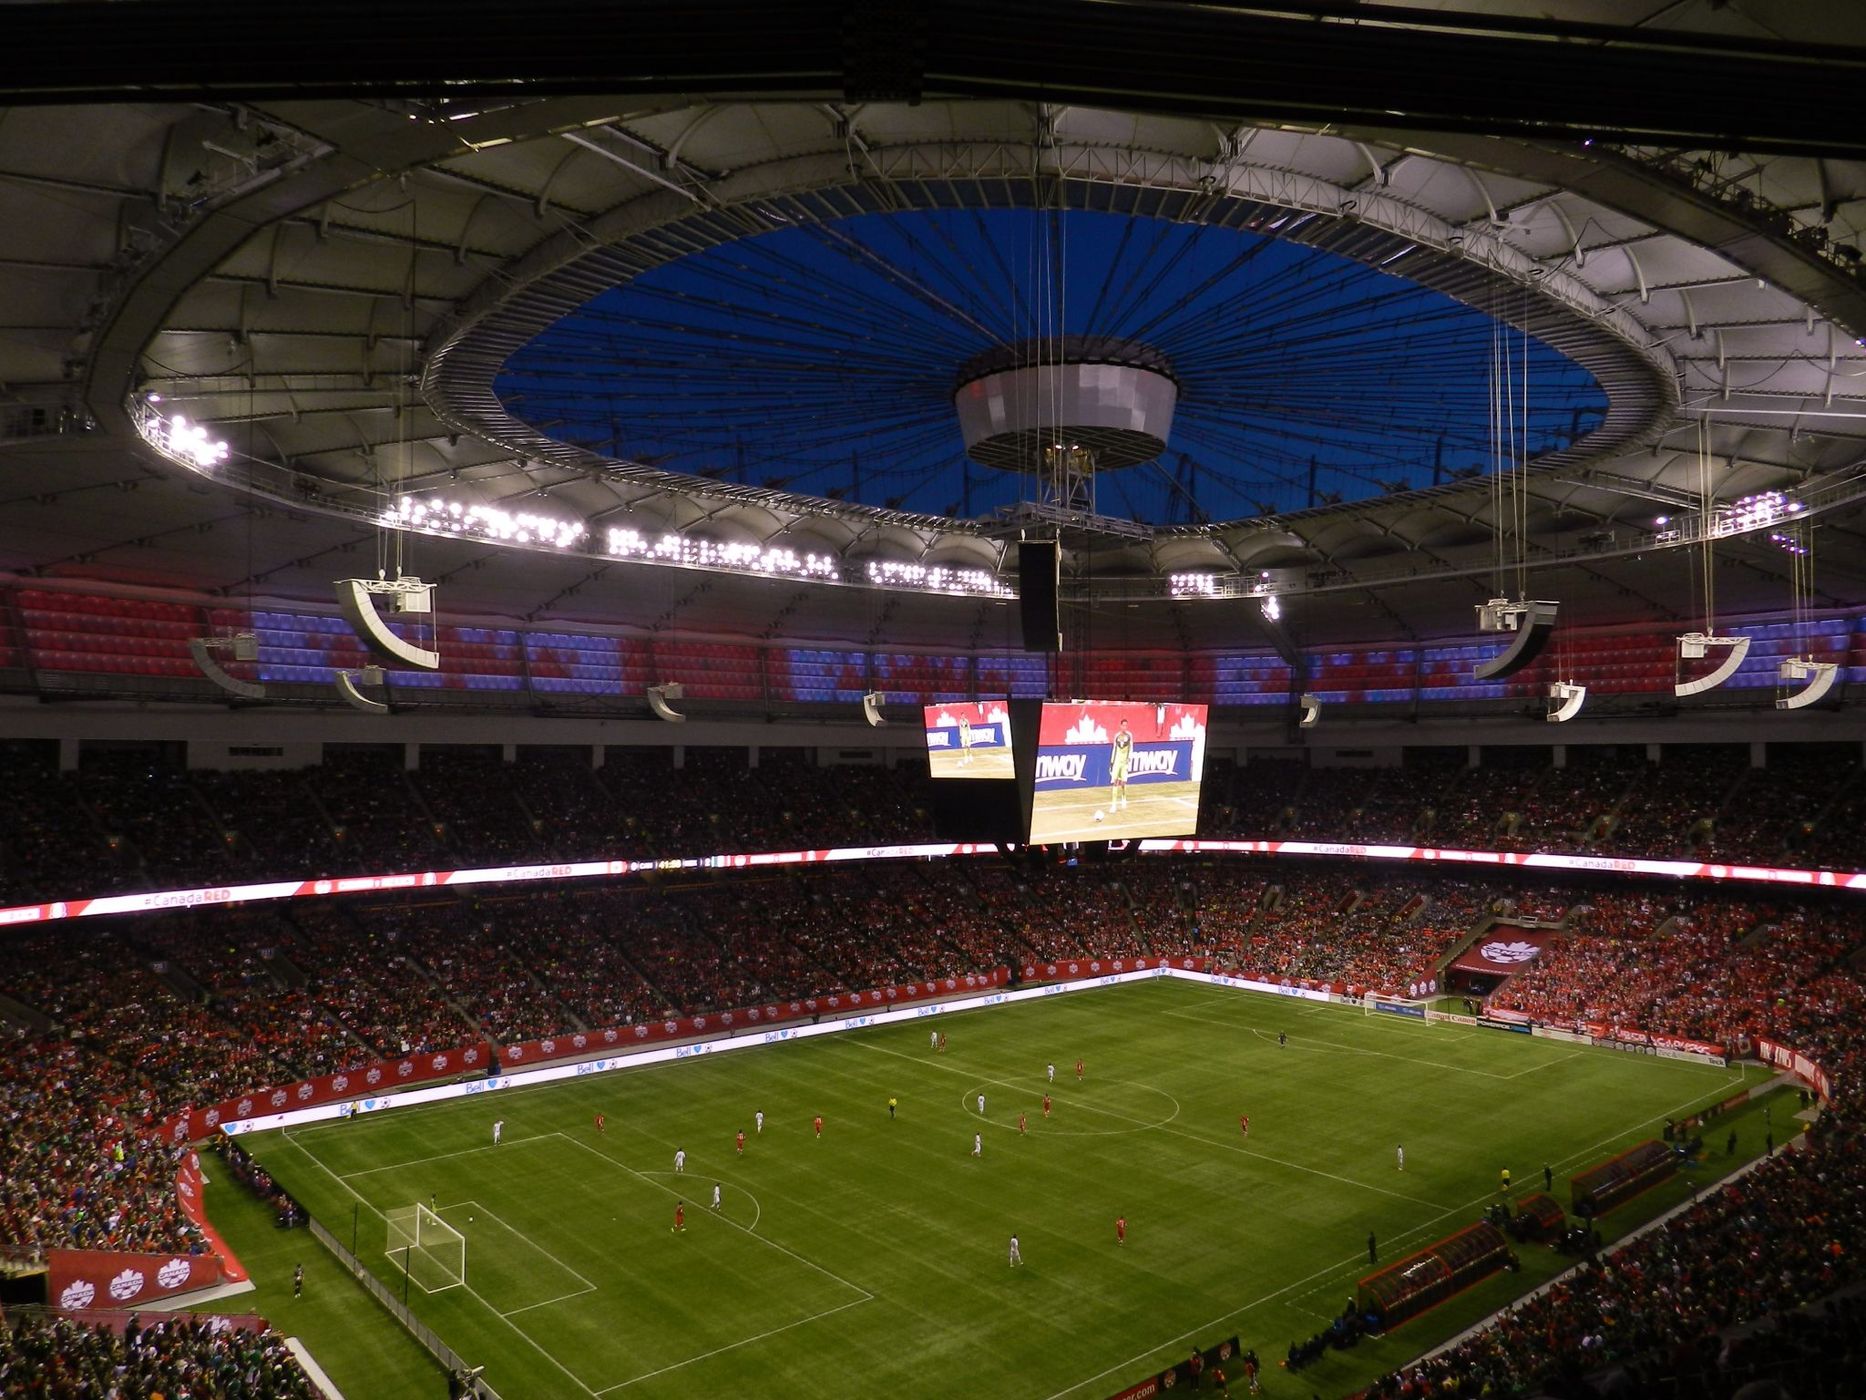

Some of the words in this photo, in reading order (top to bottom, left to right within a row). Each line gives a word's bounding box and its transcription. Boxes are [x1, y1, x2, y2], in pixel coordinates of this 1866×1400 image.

[969, 728, 994, 743] mway
[1035, 755, 1086, 781] mway
[1128, 751, 1178, 774] mway
[145, 889, 231, 906] #CanadaRED
[676, 1047, 691, 1058] Bell
[577, 1063, 594, 1075] Bell
[466, 1081, 484, 1094] Bell
[340, 1101, 360, 1115] Bel
[159, 1267, 190, 1279] CANADA
[111, 1278, 144, 1290] CANADA
[62, 1289, 94, 1302] CANADA
